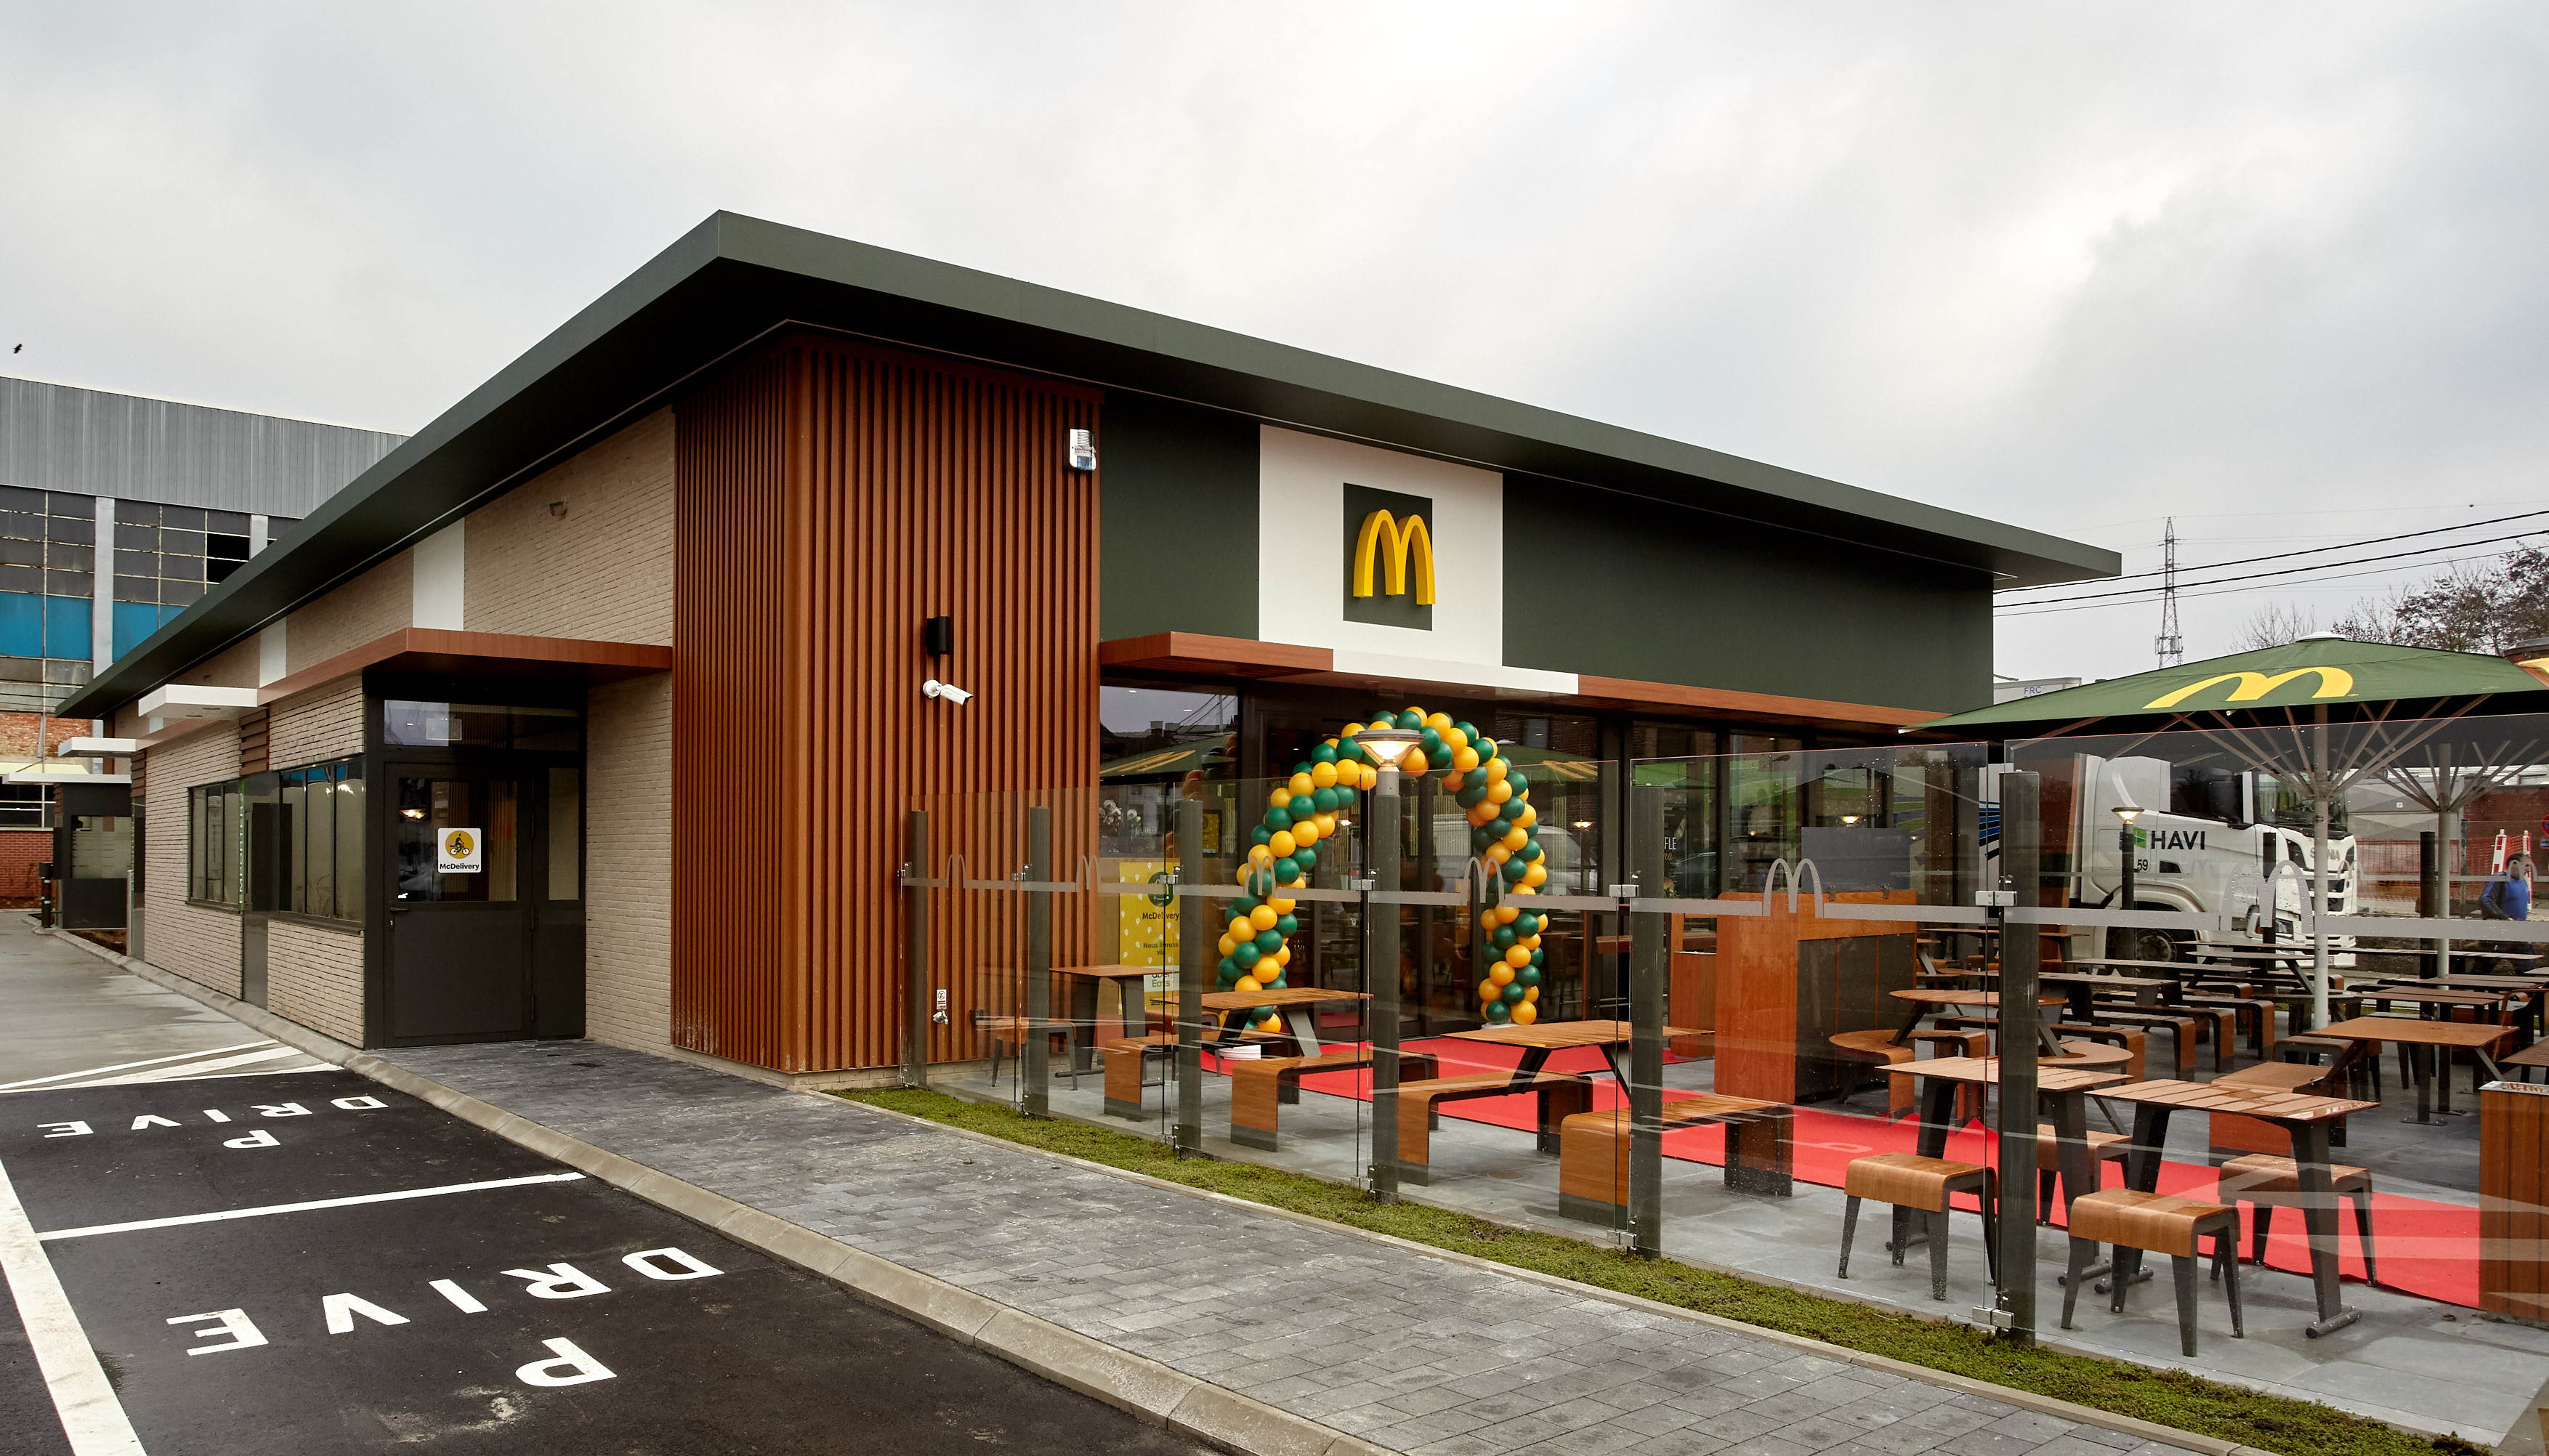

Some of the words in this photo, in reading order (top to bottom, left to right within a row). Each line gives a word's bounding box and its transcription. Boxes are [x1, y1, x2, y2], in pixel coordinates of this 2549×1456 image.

[1664, 837, 1676, 850] FLE
[2150, 830, 2205, 850] HAVI
[2309, 846, 2340, 862] SNIA
[1142, 912, 1180, 921] McDelvery
[36, 1096, 389, 1138] DRIVE
[222, 1130, 281, 1149] P
[166, 1247, 726, 1356] DRIVE
[514, 1337, 618, 1388] P
